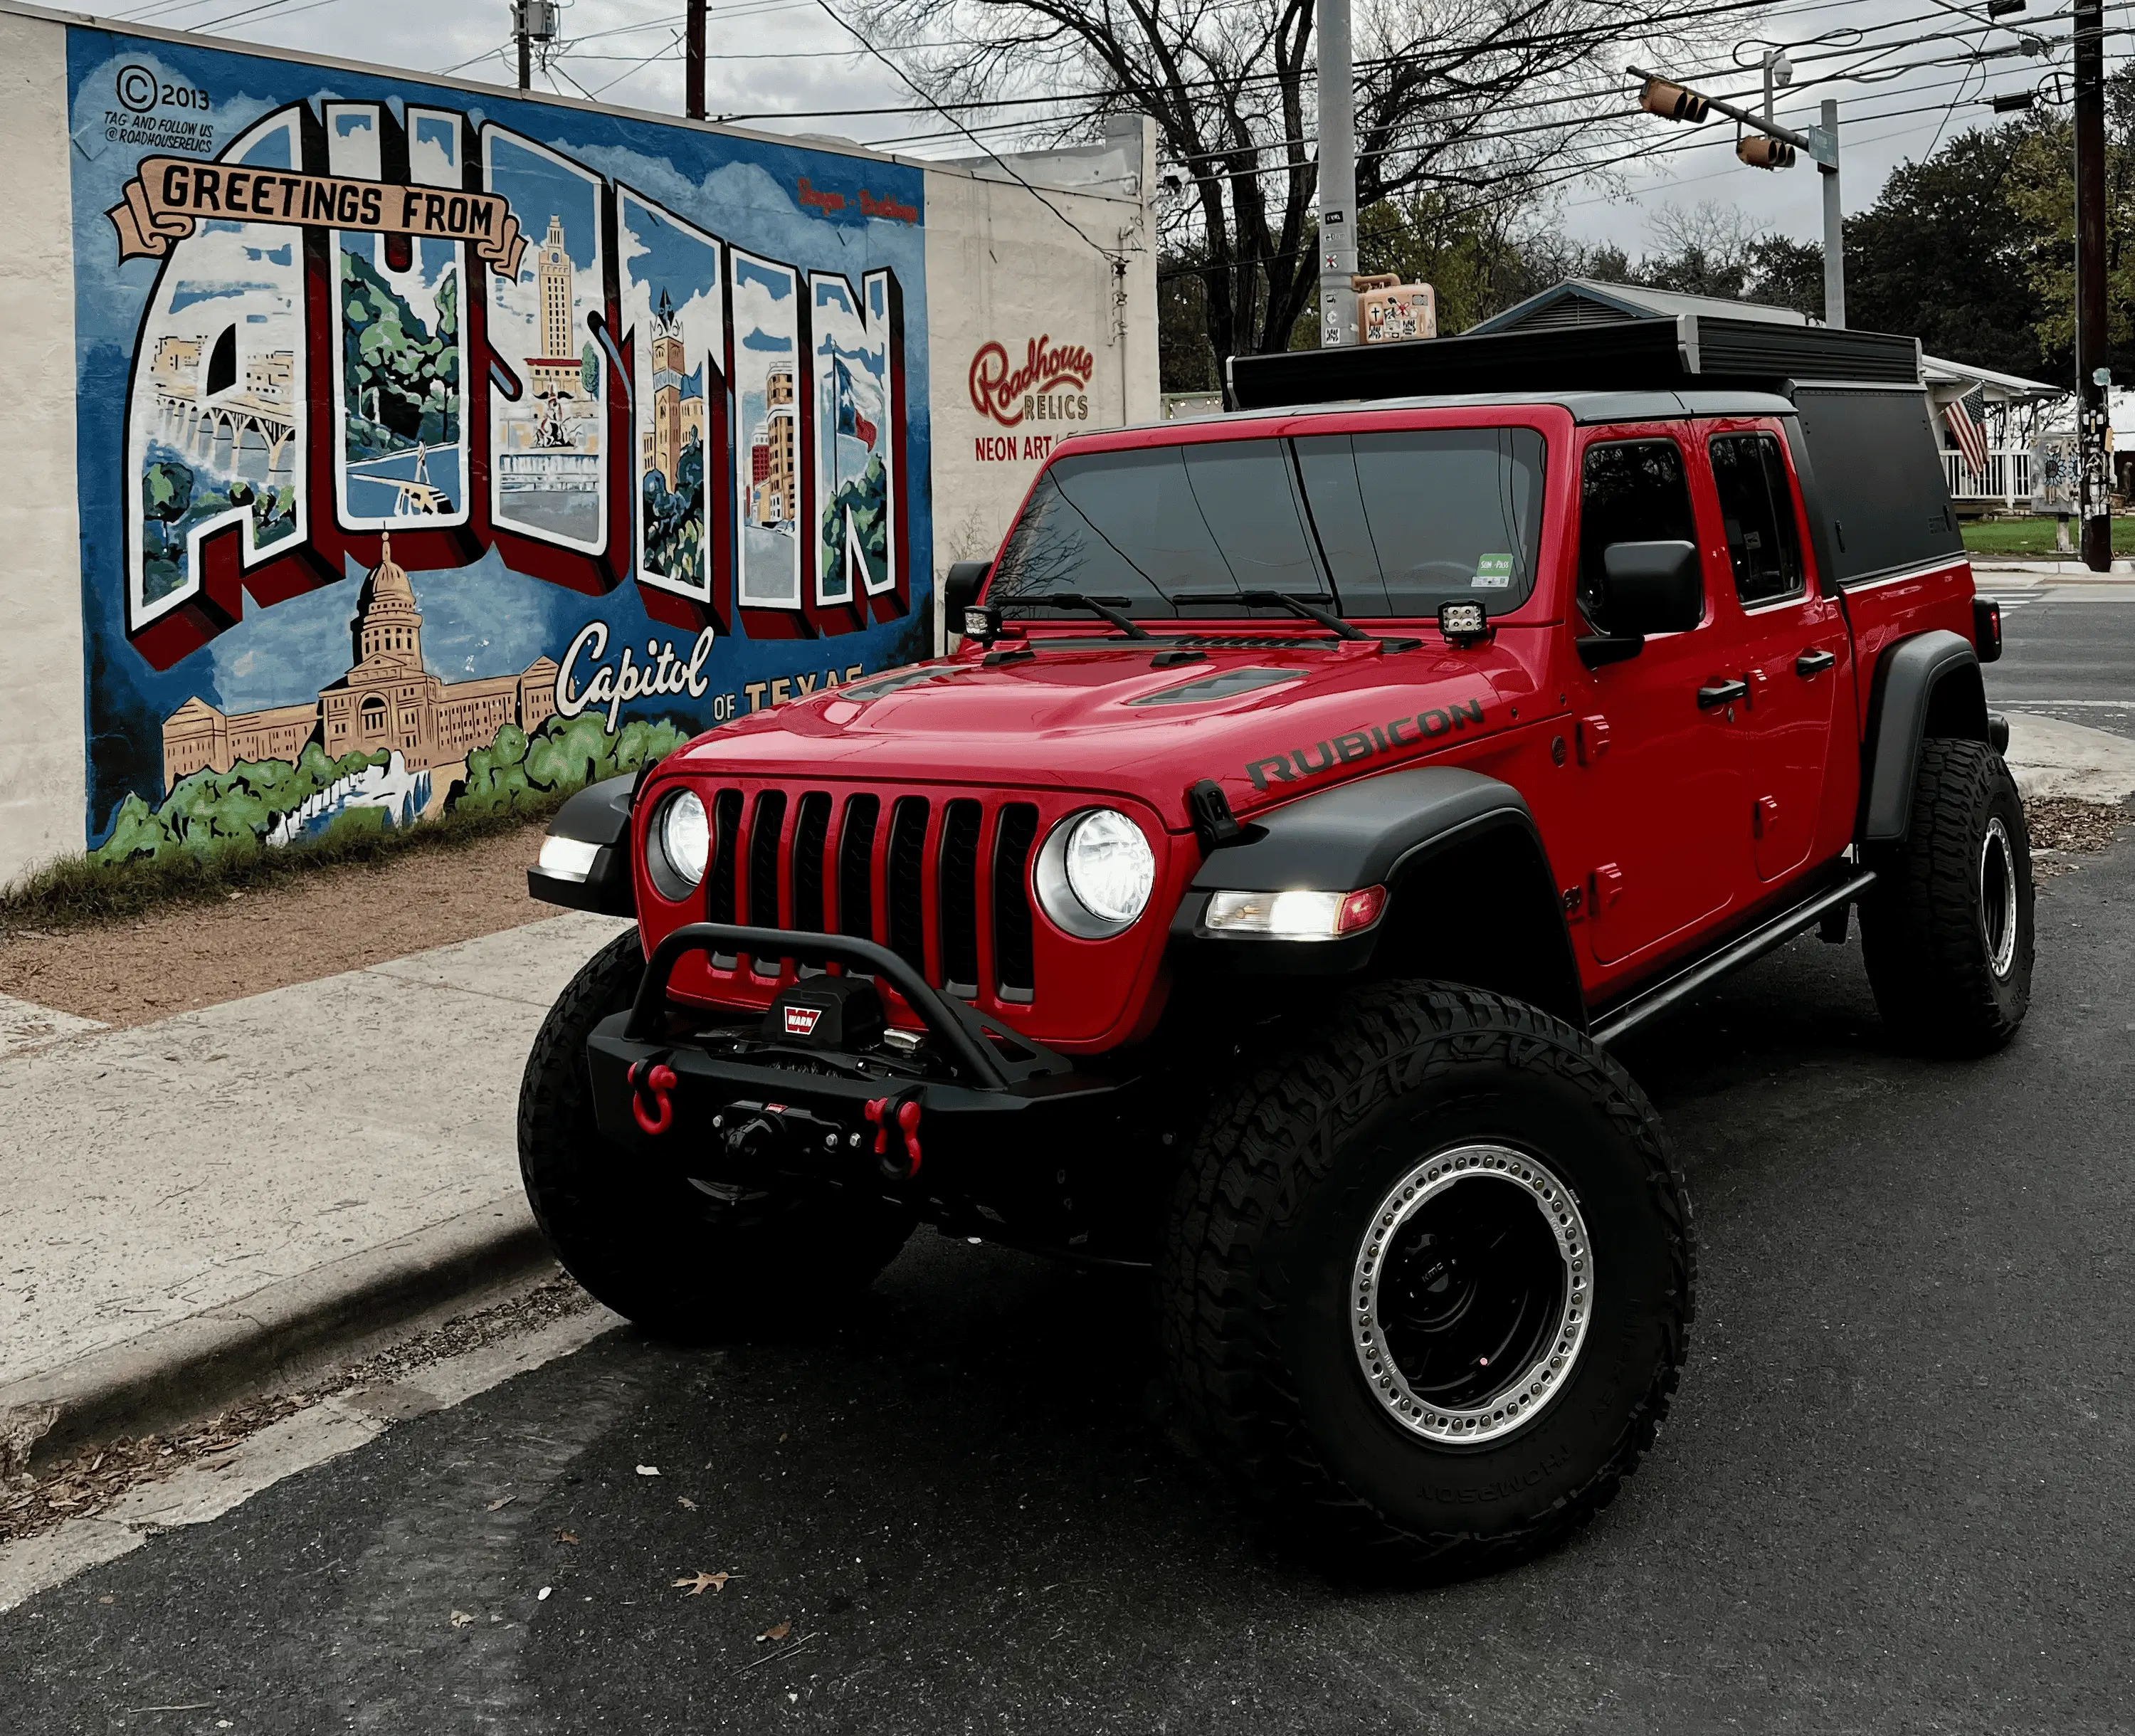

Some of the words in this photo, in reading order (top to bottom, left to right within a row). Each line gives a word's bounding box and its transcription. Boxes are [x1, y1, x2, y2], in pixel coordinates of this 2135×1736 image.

[162, 84, 210, 110] 2013
[105, 111, 127, 126] TAG
[132, 115, 156, 130] AND
[158, 119, 197, 135] FOLLOW
[199, 124, 214, 137] US
[105, 127, 212, 152] @ROADHOUSERELICS
[162, 164, 382, 226] GREETINGS
[401, 191, 492, 236] FROM
[124, 100, 905, 646] AUSTIN
[969, 334, 1093, 427] Roadhouse
[1024, 394, 1088, 421] RELICS
[975, 436, 1017, 461] NEON
[1023, 436, 1052, 460] ART
[1495, 560, 1509, 569] PASS
[556, 620, 714, 735] Capitol
[713, 693, 736, 720] OF
[1244, 698, 1485, 791] RUBICON
[788, 1014, 813, 1027] WARN
